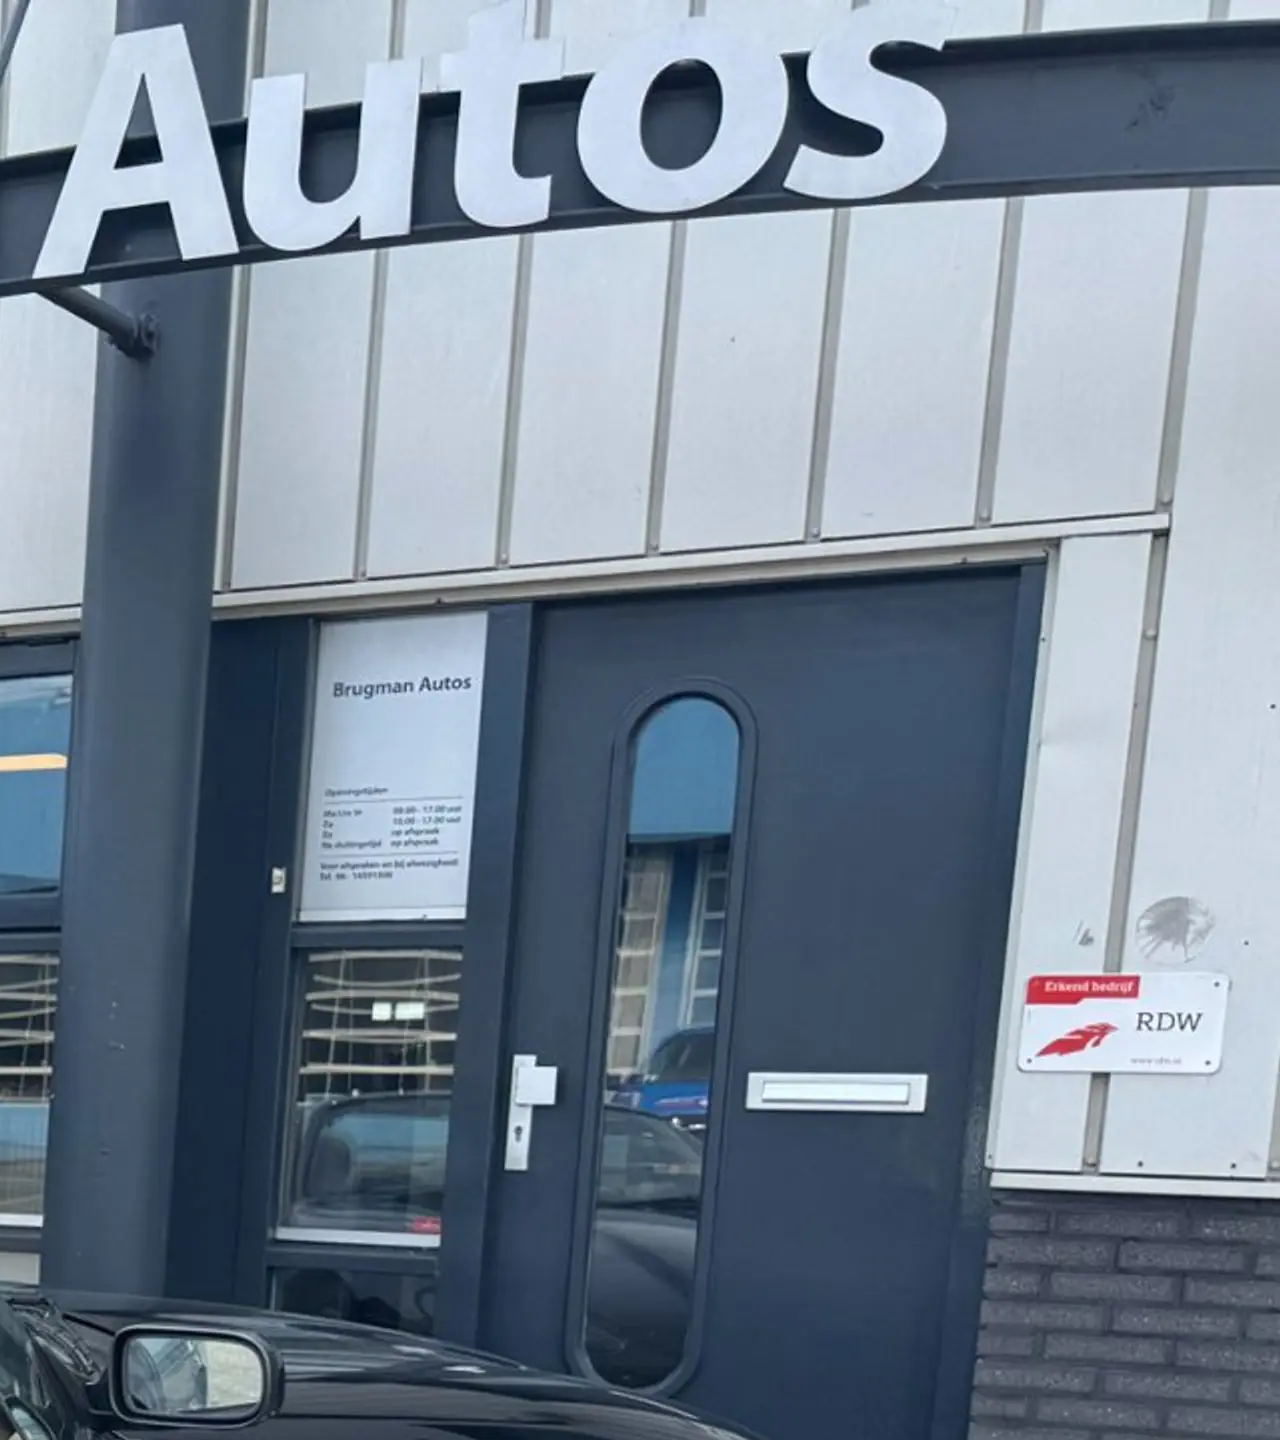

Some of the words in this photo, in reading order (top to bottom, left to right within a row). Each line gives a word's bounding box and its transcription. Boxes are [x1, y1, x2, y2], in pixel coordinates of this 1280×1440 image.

[32, 0, 956, 278] Autos
[332, 681, 414, 699] Brugman
[418, 675, 472, 692] Autos
[1044, 980, 1089, 993] Erkend
[1091, 981, 1134, 996] bedrijf
[1136, 1011, 1204, 1033] RDW
